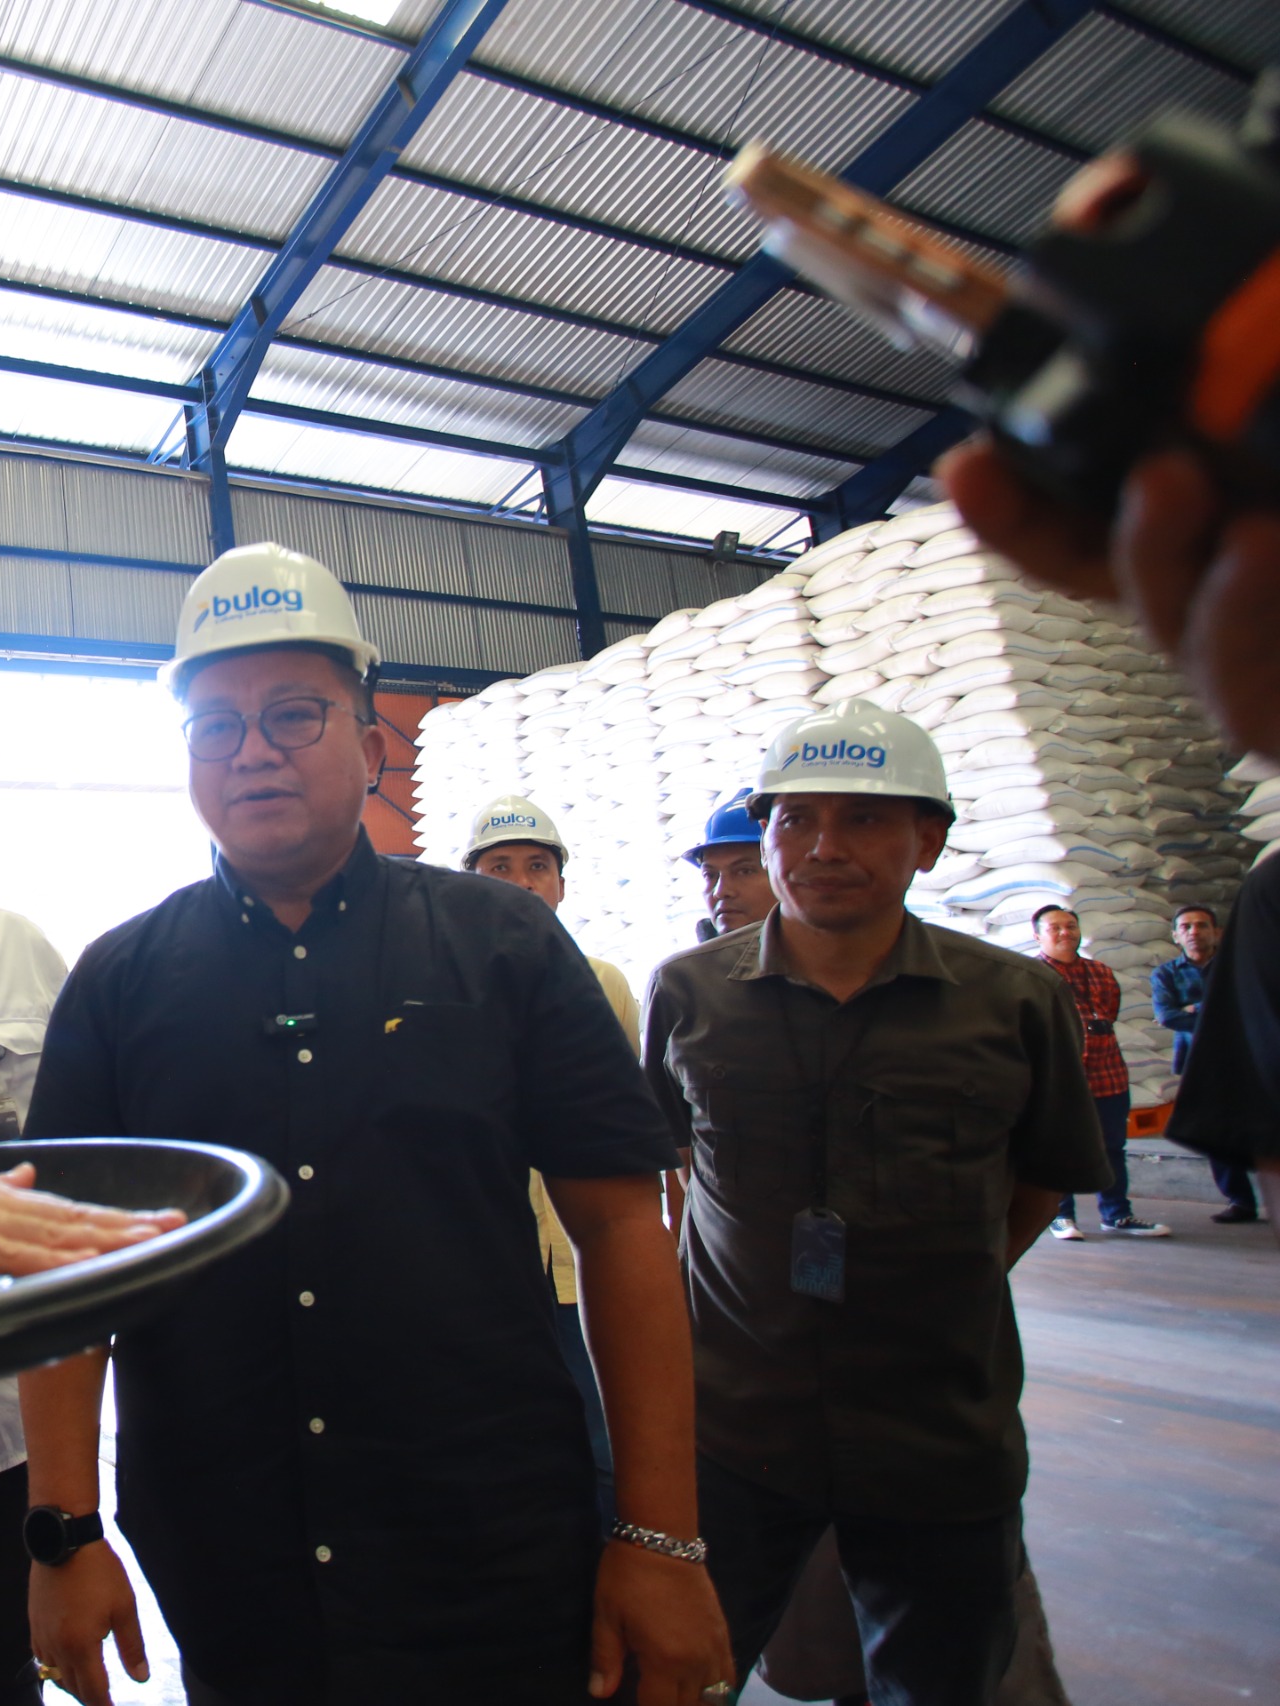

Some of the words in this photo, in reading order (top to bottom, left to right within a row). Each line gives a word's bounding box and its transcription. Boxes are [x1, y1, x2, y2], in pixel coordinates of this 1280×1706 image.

[213, 585, 302, 617] bulog
[801, 739, 886, 768] bulog
[491, 813, 536, 828] bulog
